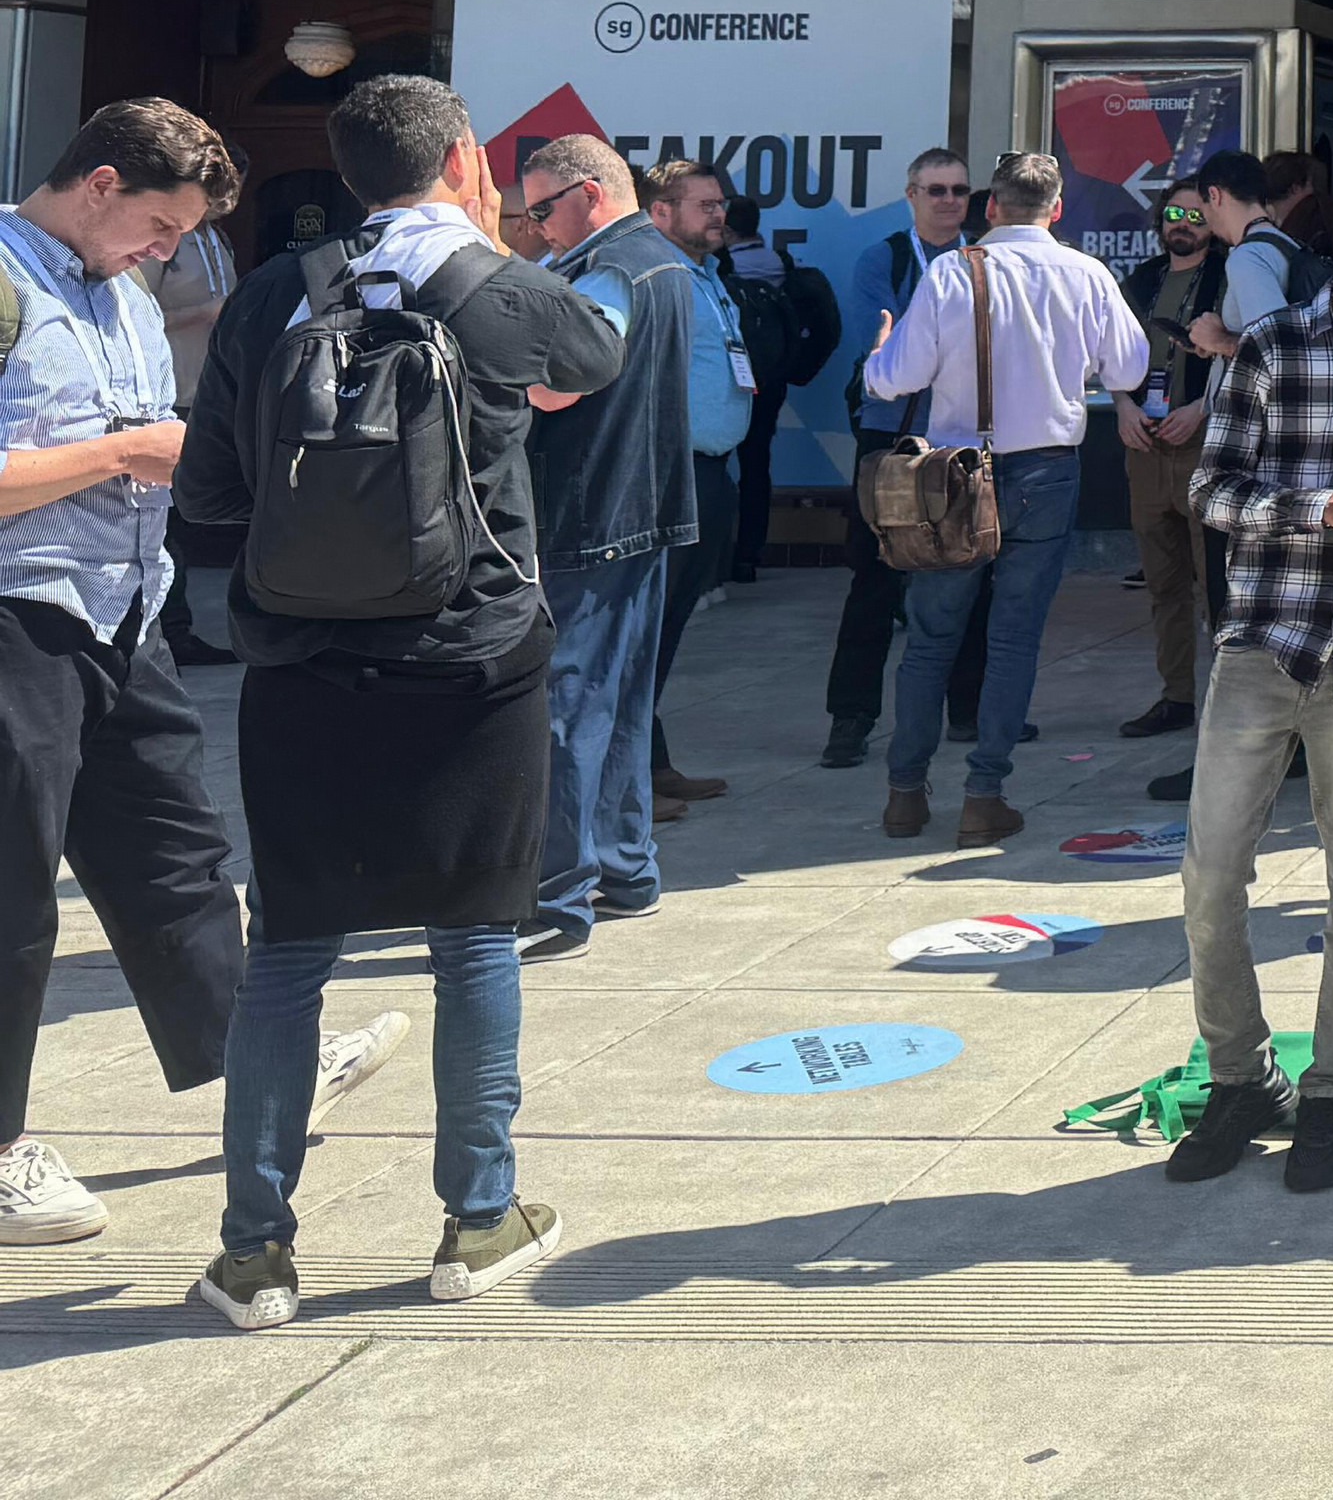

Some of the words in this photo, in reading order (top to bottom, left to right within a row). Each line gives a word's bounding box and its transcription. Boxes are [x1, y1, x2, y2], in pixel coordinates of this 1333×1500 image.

[607, 20, 633, 38] sg
[650, 13, 809, 40] CONFERENCE
[1126, 97, 1195, 110] CONFERENCE
[792, 1036, 842, 1085] NETWORKING
[832, 1041, 872, 1069] TABLES
